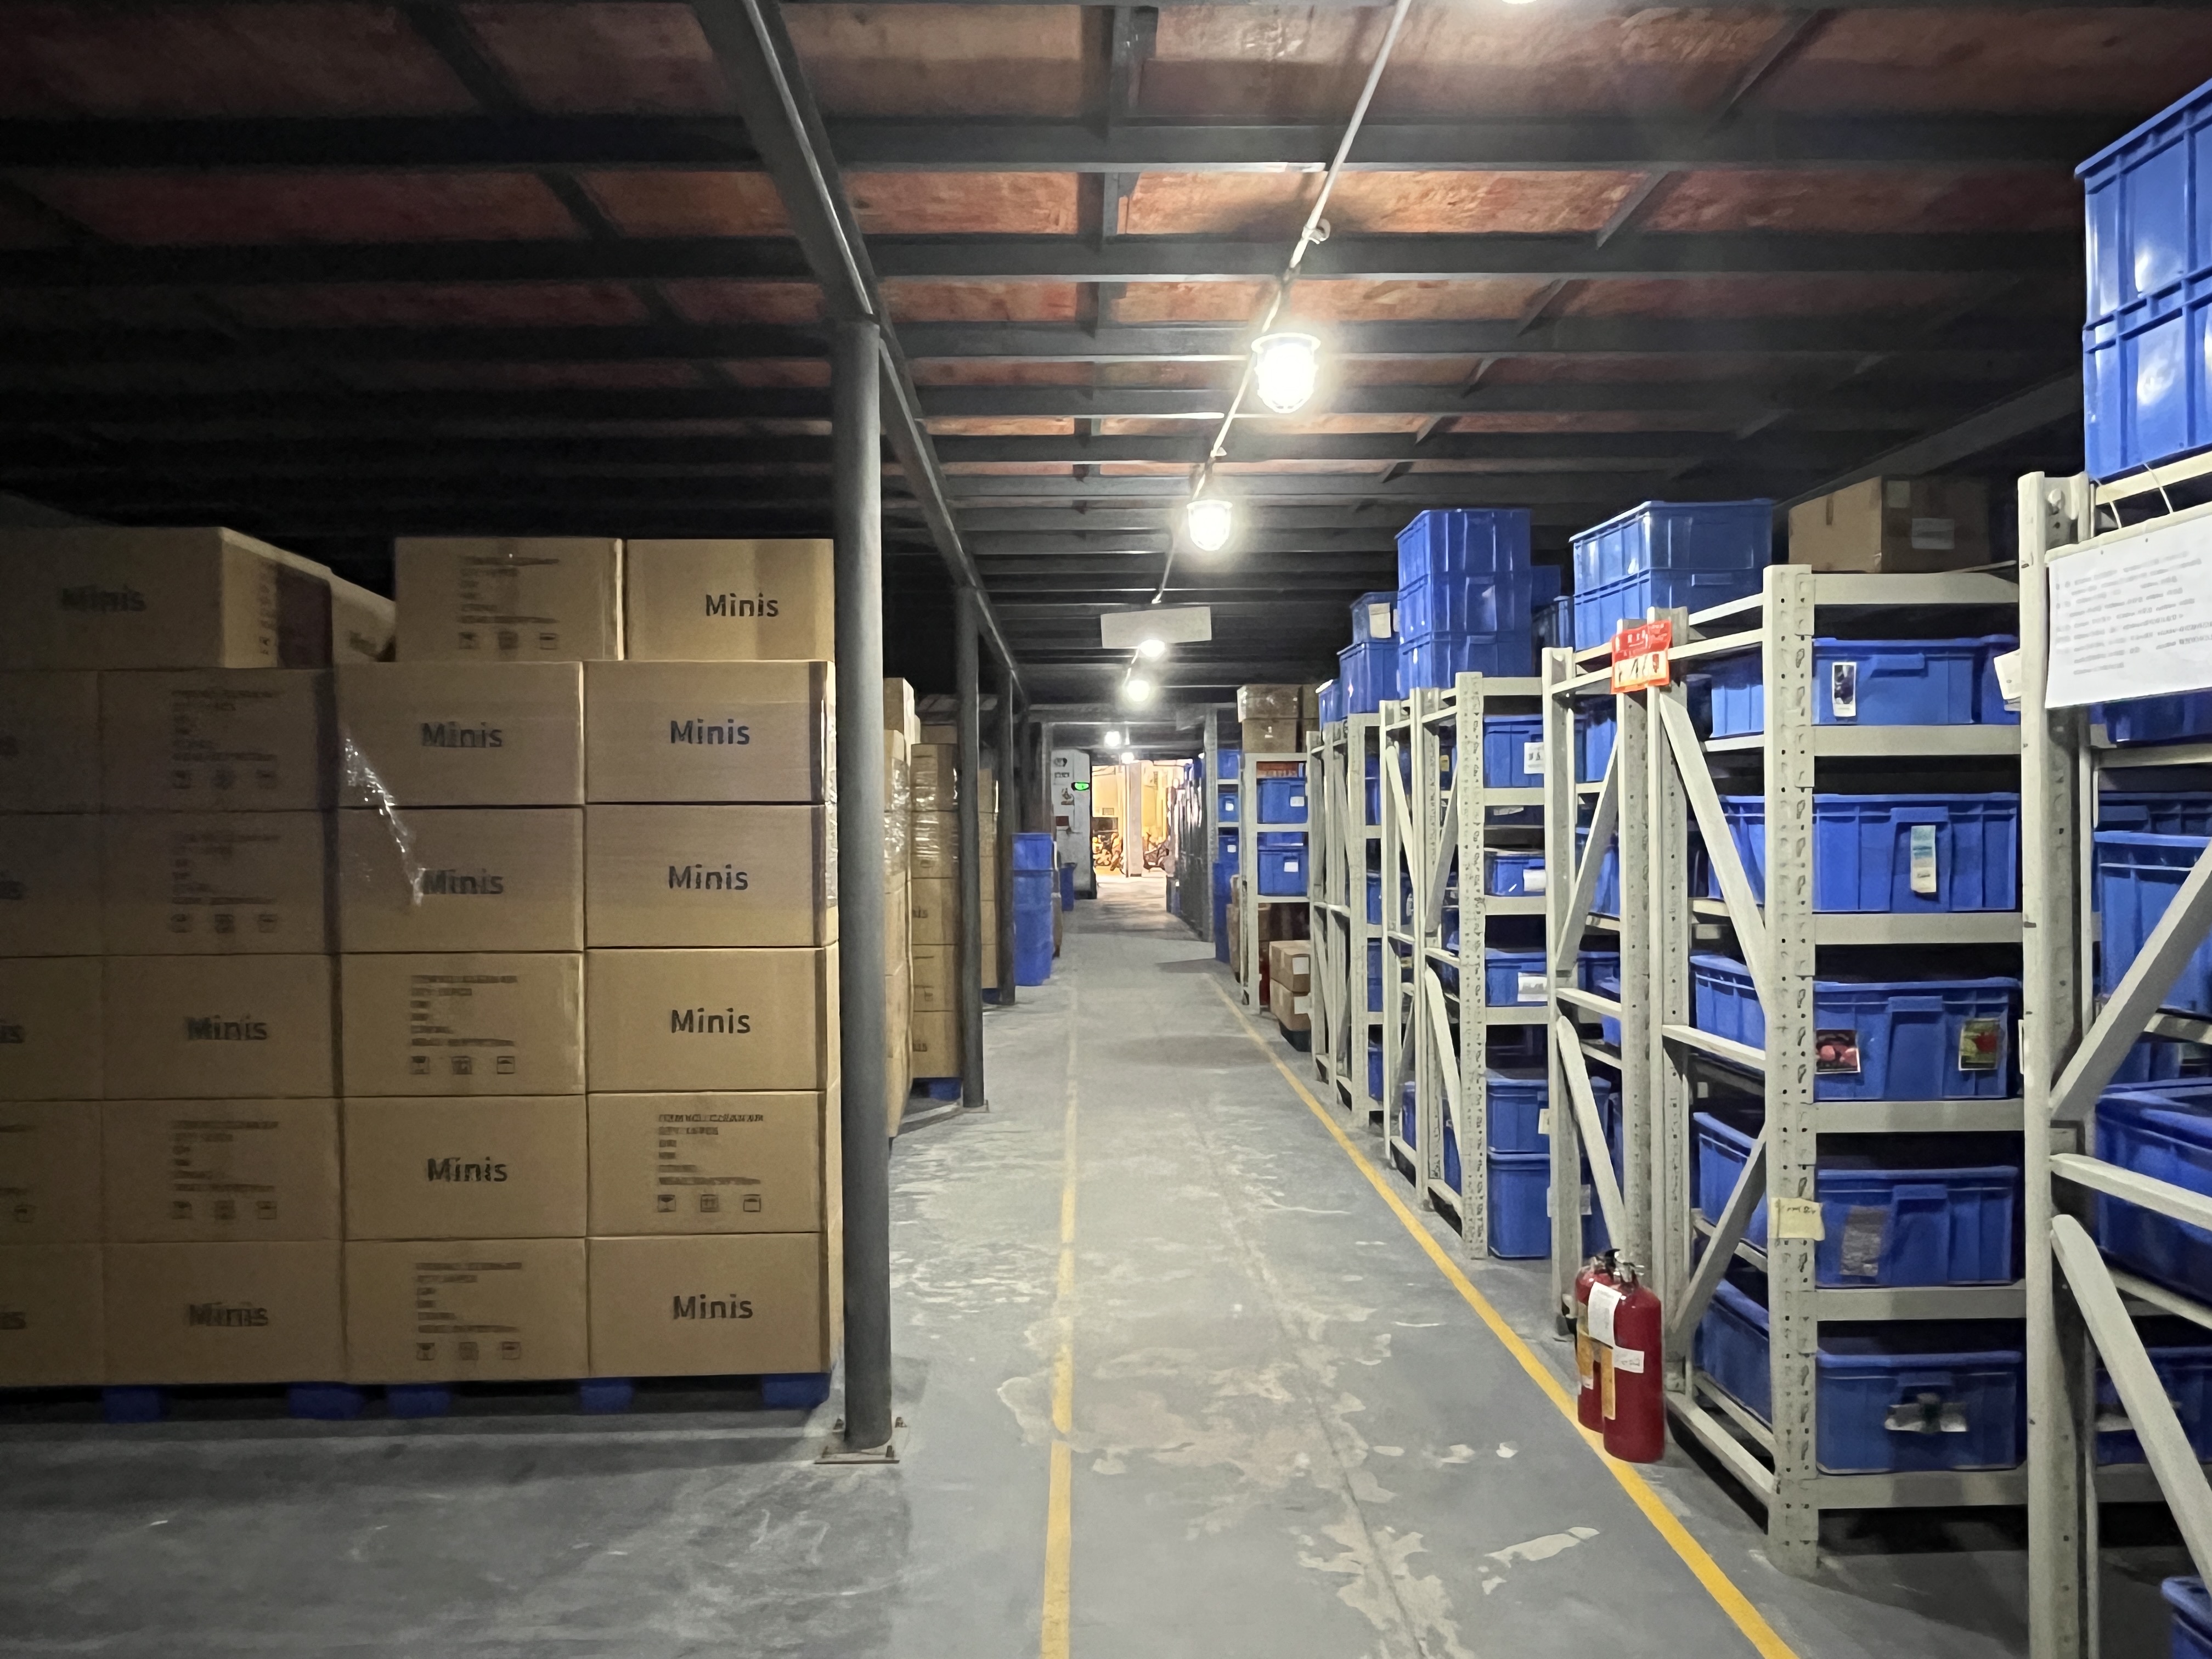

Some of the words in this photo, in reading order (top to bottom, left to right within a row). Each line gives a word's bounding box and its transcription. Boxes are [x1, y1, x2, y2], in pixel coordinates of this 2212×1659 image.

[706, 593, 779, 618] Minis
[421, 721, 503, 748] Minis
[670, 718, 751, 745] Minis
[423, 869, 504, 895] Minis
[668, 864, 749, 891] Minis
[187, 1015, 268, 1041] Minis
[671, 1008, 751, 1034] Minis
[427, 1156, 508, 1182] Minis
[673, 1294, 754, 1320] Minis
